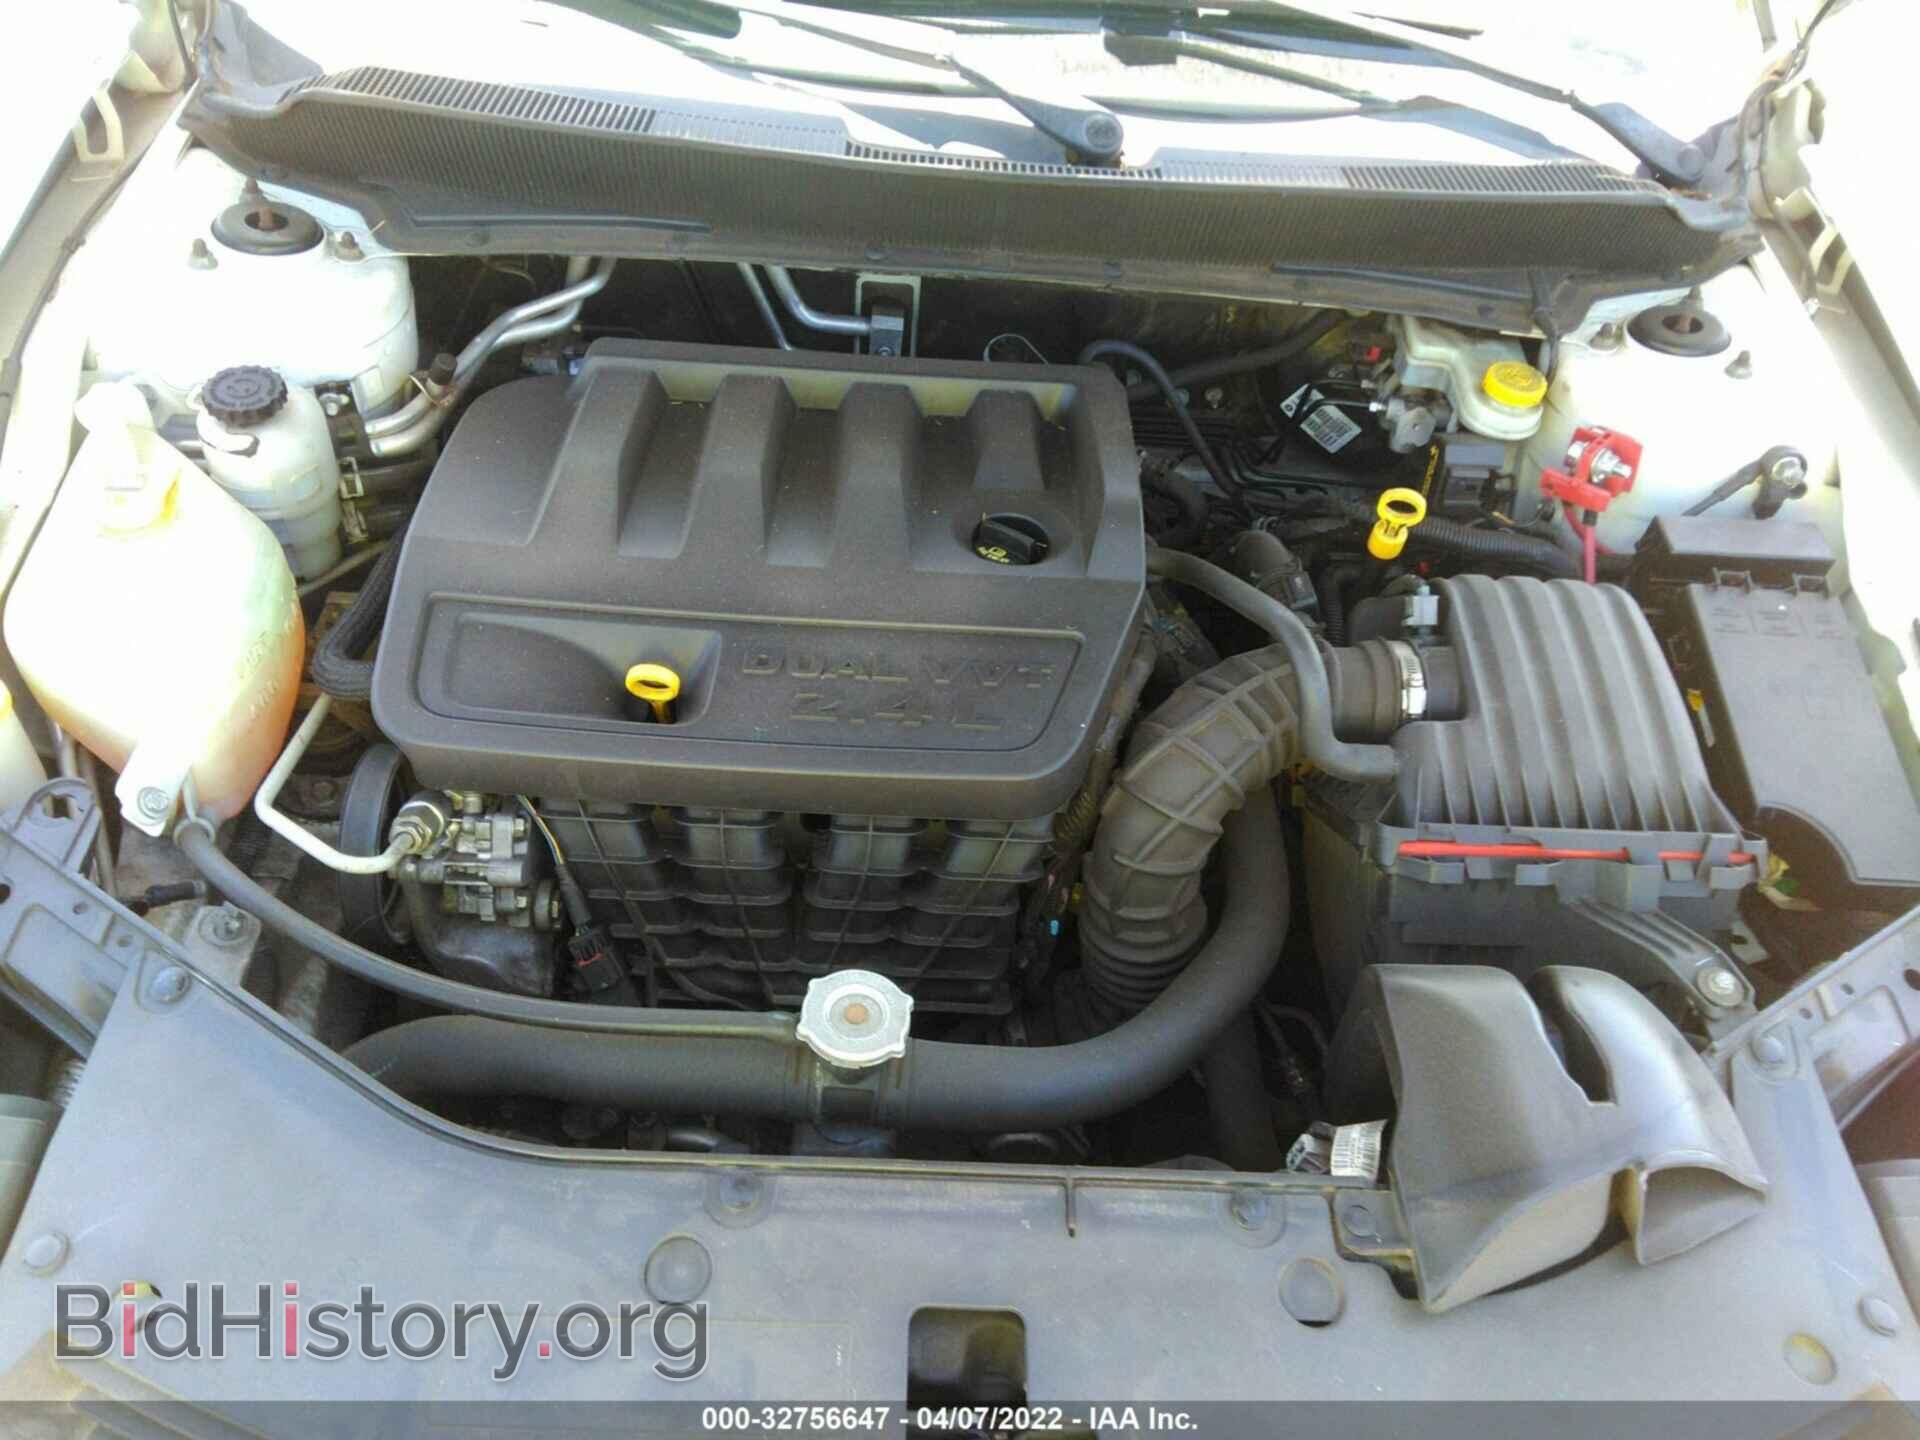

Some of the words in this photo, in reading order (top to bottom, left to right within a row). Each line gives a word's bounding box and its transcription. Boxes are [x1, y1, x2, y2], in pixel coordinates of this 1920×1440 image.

[742, 651, 910, 682] DUAL
[928, 657, 1057, 689] VVT
[789, 692, 1002, 730] 2.4L
